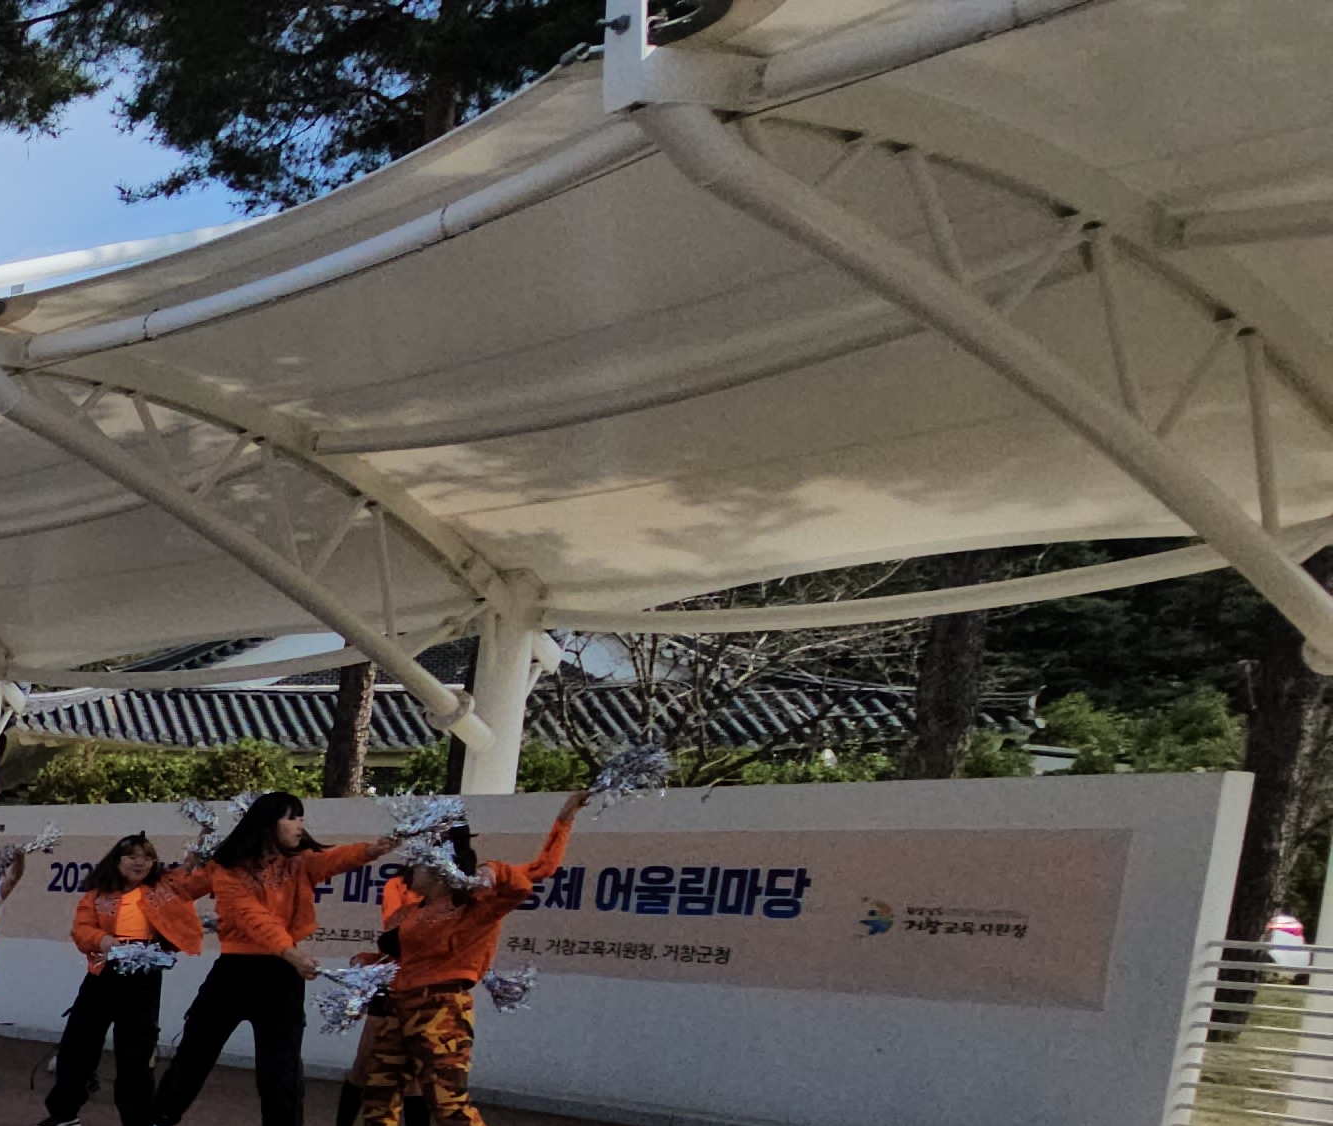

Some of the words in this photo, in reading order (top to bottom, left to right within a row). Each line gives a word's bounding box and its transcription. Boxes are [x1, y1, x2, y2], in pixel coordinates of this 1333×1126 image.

[47, 861, 95, 893] 202
[594, 864, 812, 919] 어울림마당
[901, 916, 1029, 939] 거창교육지원청
[544, 937, 658, 961] 거창교육지원청,
[662, 944, 731, 965] 거창군청
